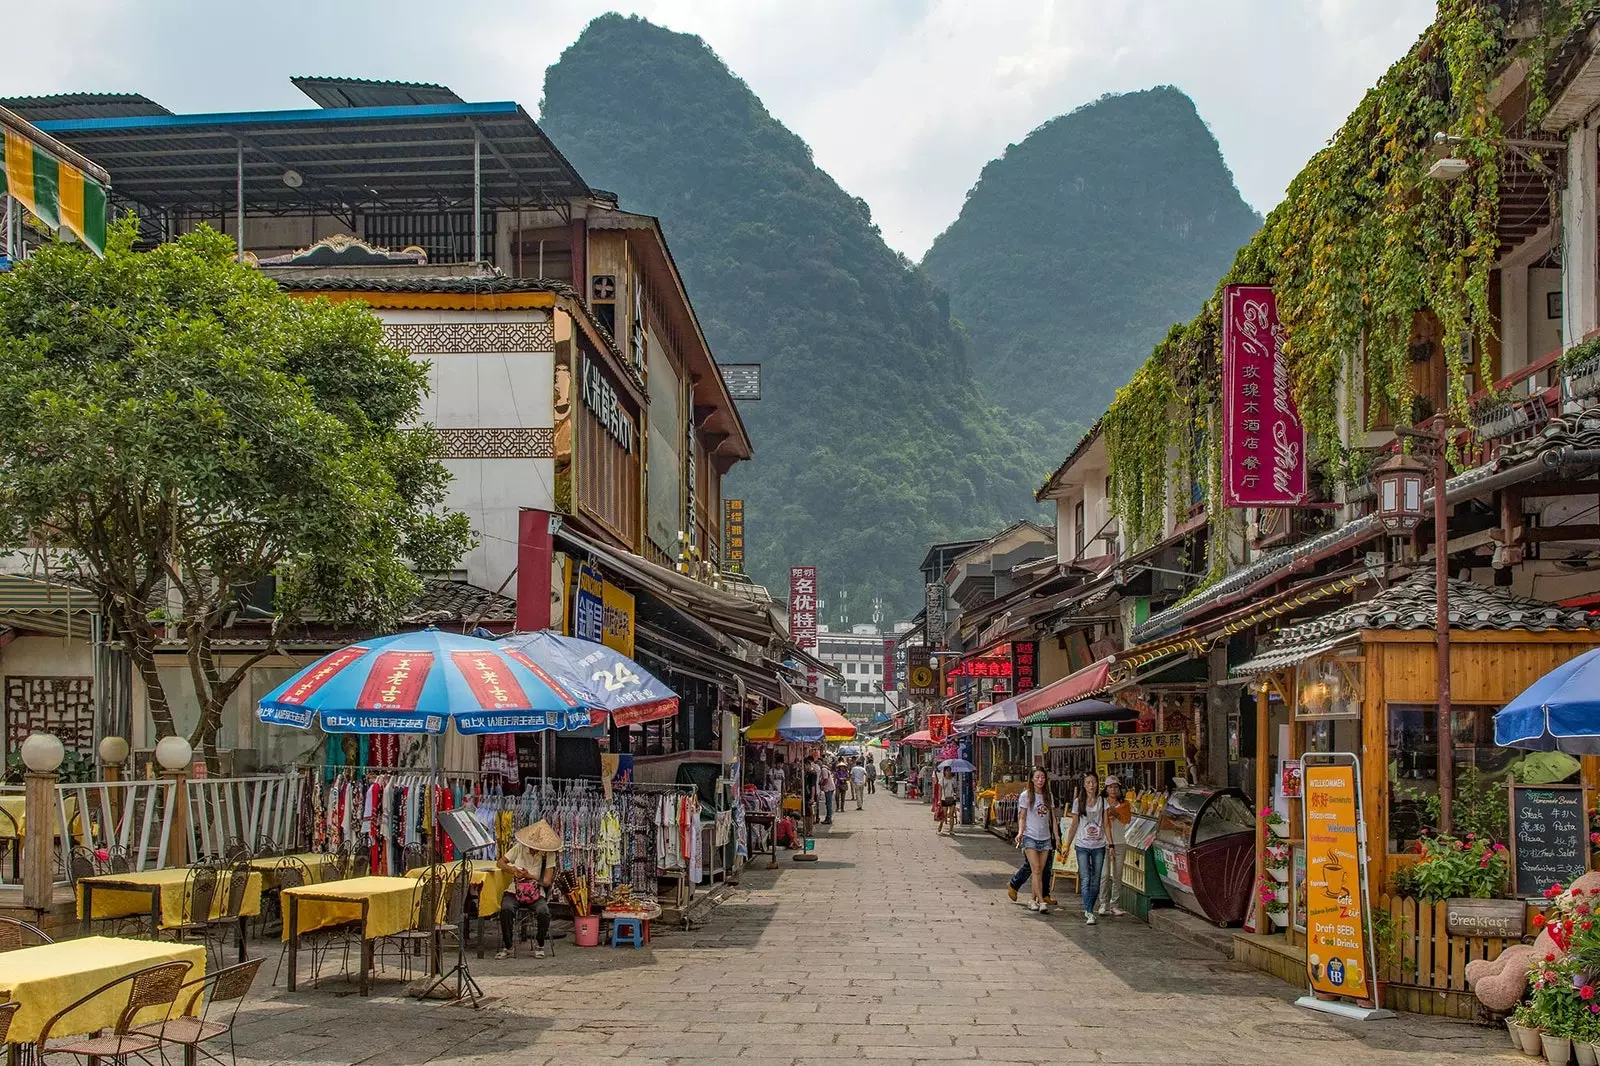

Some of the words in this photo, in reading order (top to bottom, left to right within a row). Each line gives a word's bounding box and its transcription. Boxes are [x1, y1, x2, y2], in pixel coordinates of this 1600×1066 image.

[1241, 366, 1261, 490] 玫瑰木酒店餐厅
[380, 659, 413, 702] 王老吉
[472, 658, 509, 702] 王老吉
[591, 662, 641, 692] 24
[326, 715, 356, 727] 怕上火
[359, 716, 423, 729] 认准正宗王老吉
[460, 716, 486, 729] 怕上火
[1519, 807, 1544, 820] Steak
[1327, 822, 1356, 833] Welcome
[1552, 820, 1577, 831] Pasta
[1449, 912, 1510, 928] Breakfast
[1315, 922, 1335, 933] Draft
[1336, 925, 1355, 936] BEER
[1336, 939, 1359, 949] Drinks
